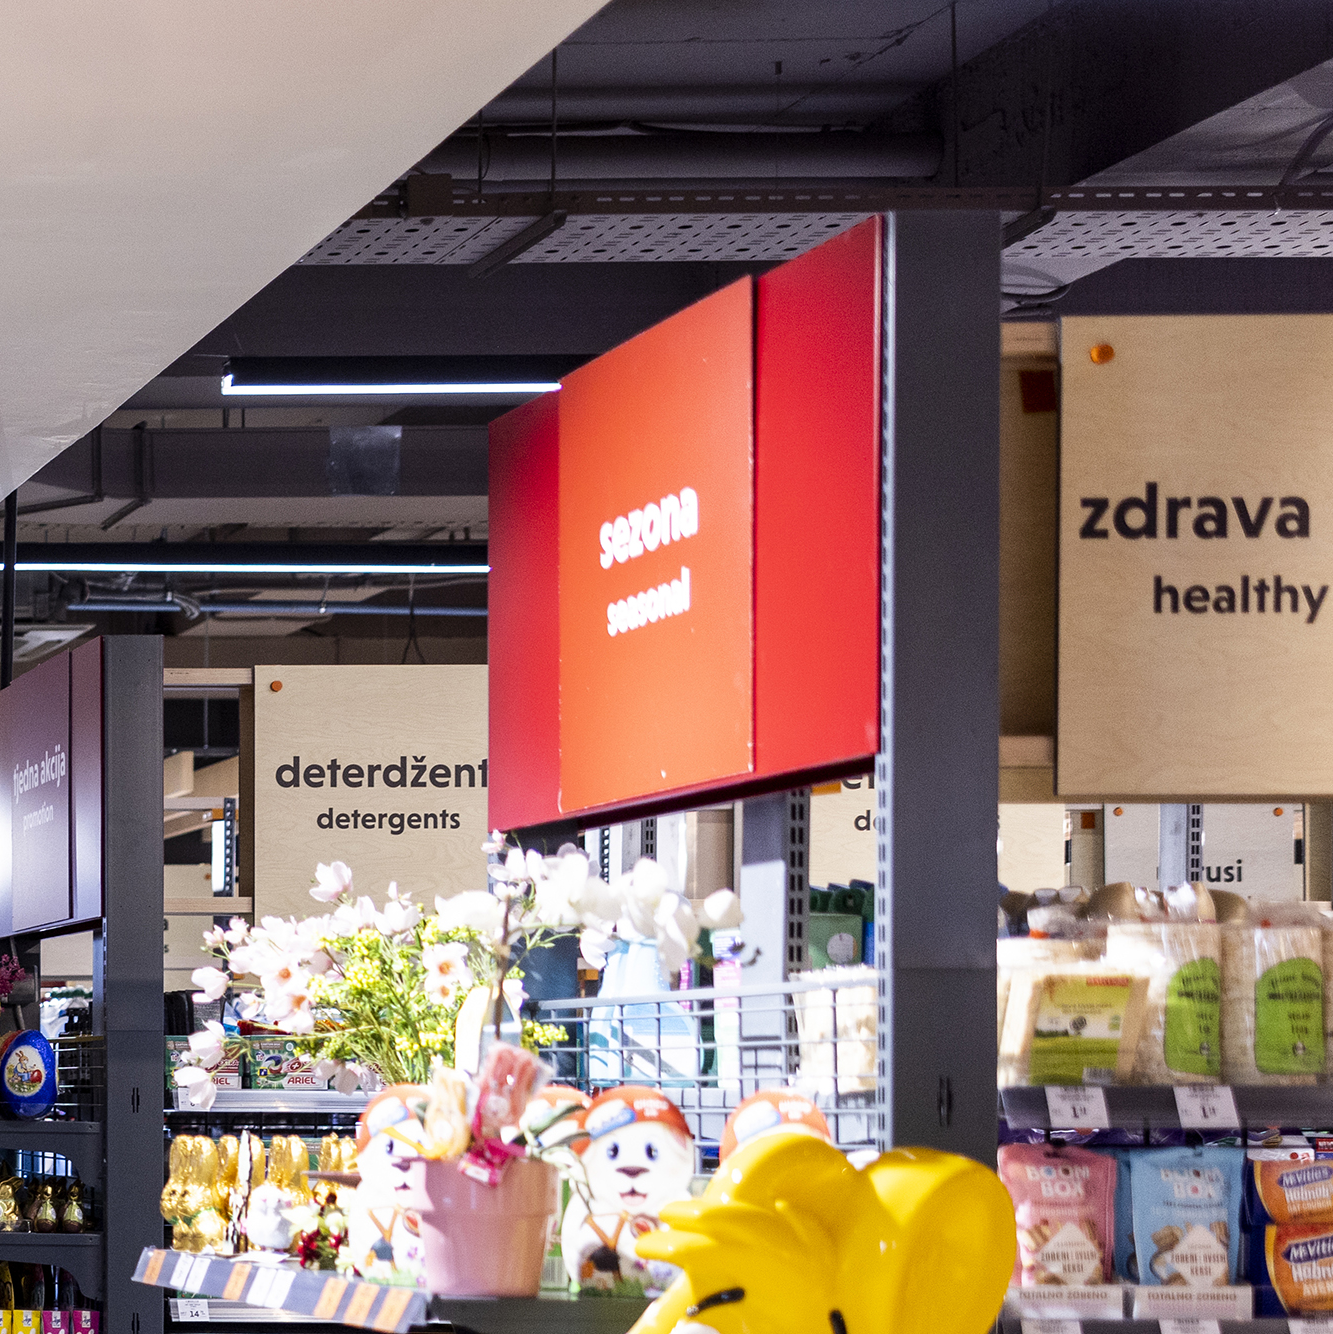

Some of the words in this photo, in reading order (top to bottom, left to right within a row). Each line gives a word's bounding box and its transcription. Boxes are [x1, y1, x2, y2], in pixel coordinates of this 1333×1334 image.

[599, 486, 699, 569] sezona
[1078, 481, 1312, 541] zdrava
[606, 567, 690, 636] seasonal
[1152, 574, 1329, 624] healthy
[13, 759, 39, 804] tjedna
[40, 744, 66, 788] akcija
[275, 754, 488, 789] deterdžent
[23, 802, 54, 837] promotion
[316, 808, 460, 835] detergents
[213, 1077, 230, 1085] RIEL
[288, 1077, 316, 1085] ARIEL
[1041, 1181, 1083, 1197] BOX
